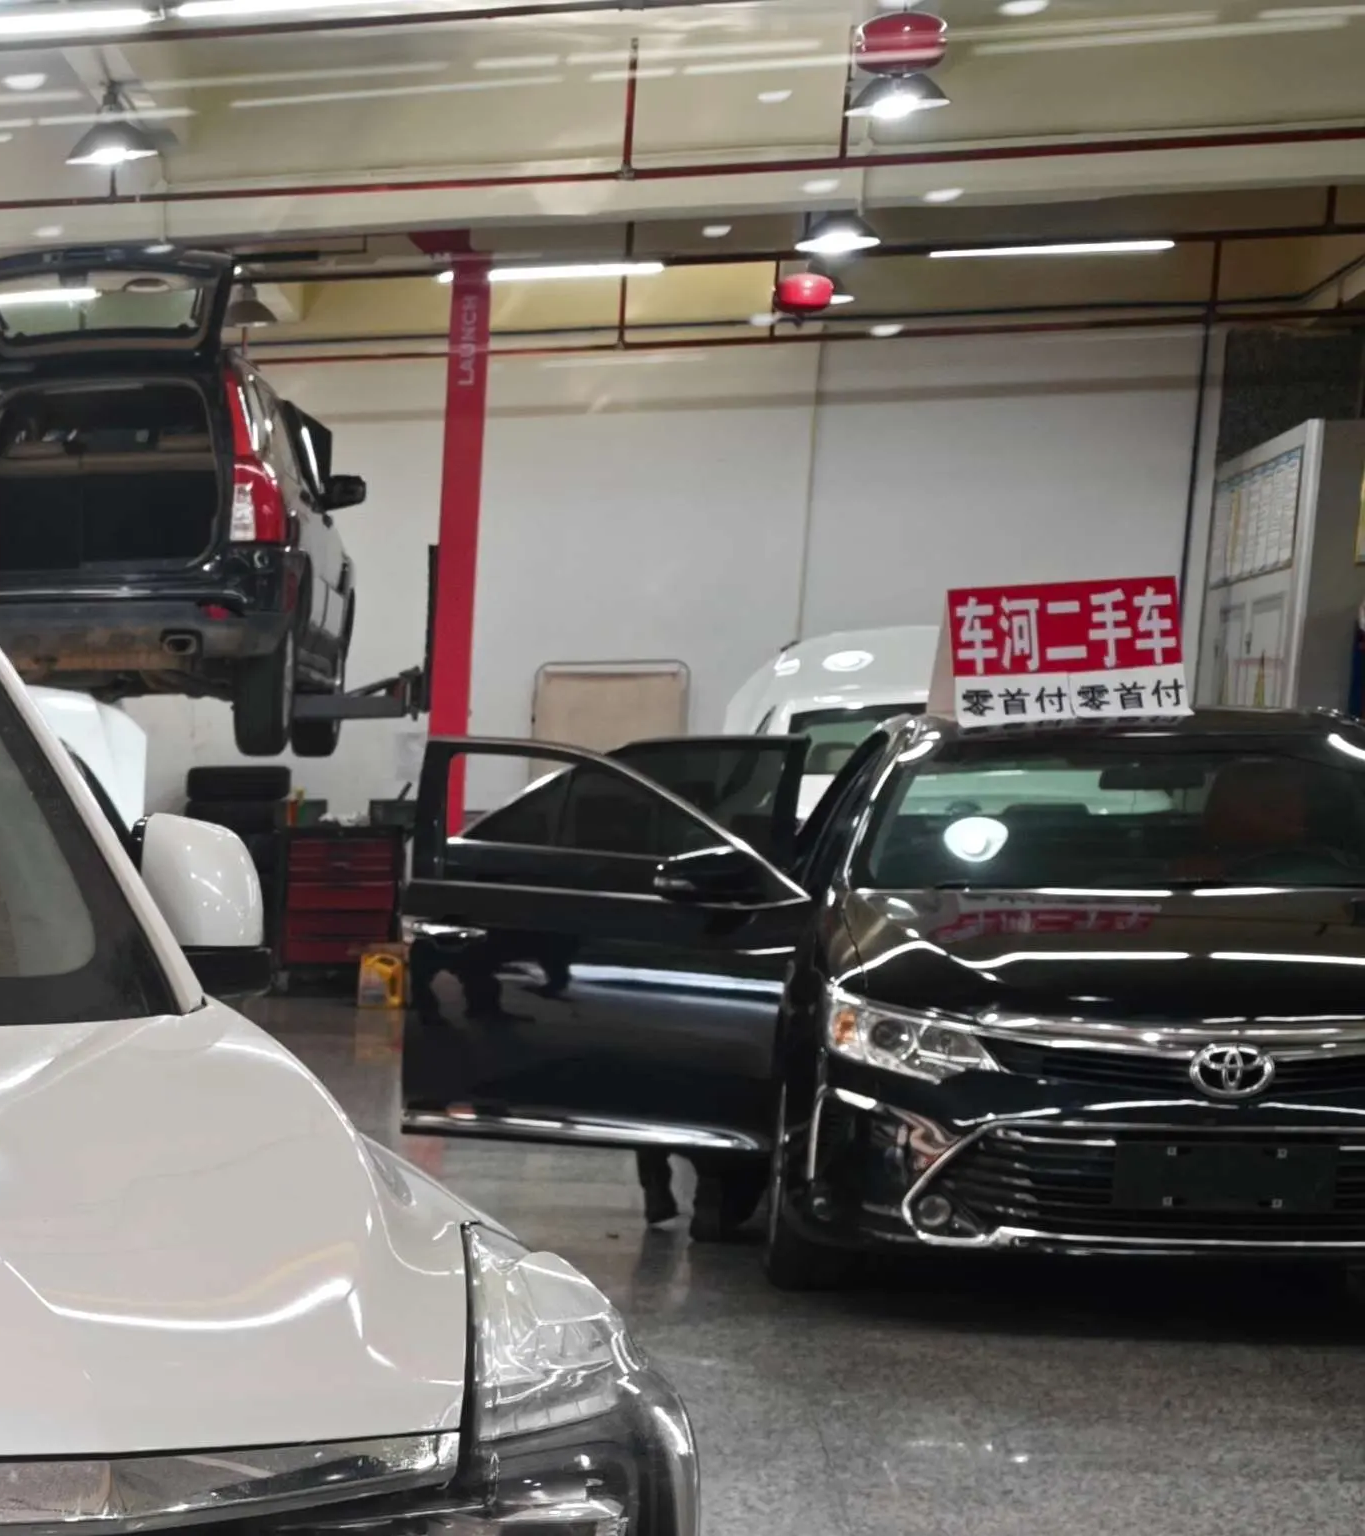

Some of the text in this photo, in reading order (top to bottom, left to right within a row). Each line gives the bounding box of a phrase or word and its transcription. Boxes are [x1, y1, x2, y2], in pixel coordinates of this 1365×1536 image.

[457, 295, 478, 387] LAUNCH
[955, 585, 1178, 676] 车河二手车
[961, 678, 1185, 717] 零首付 零首付
